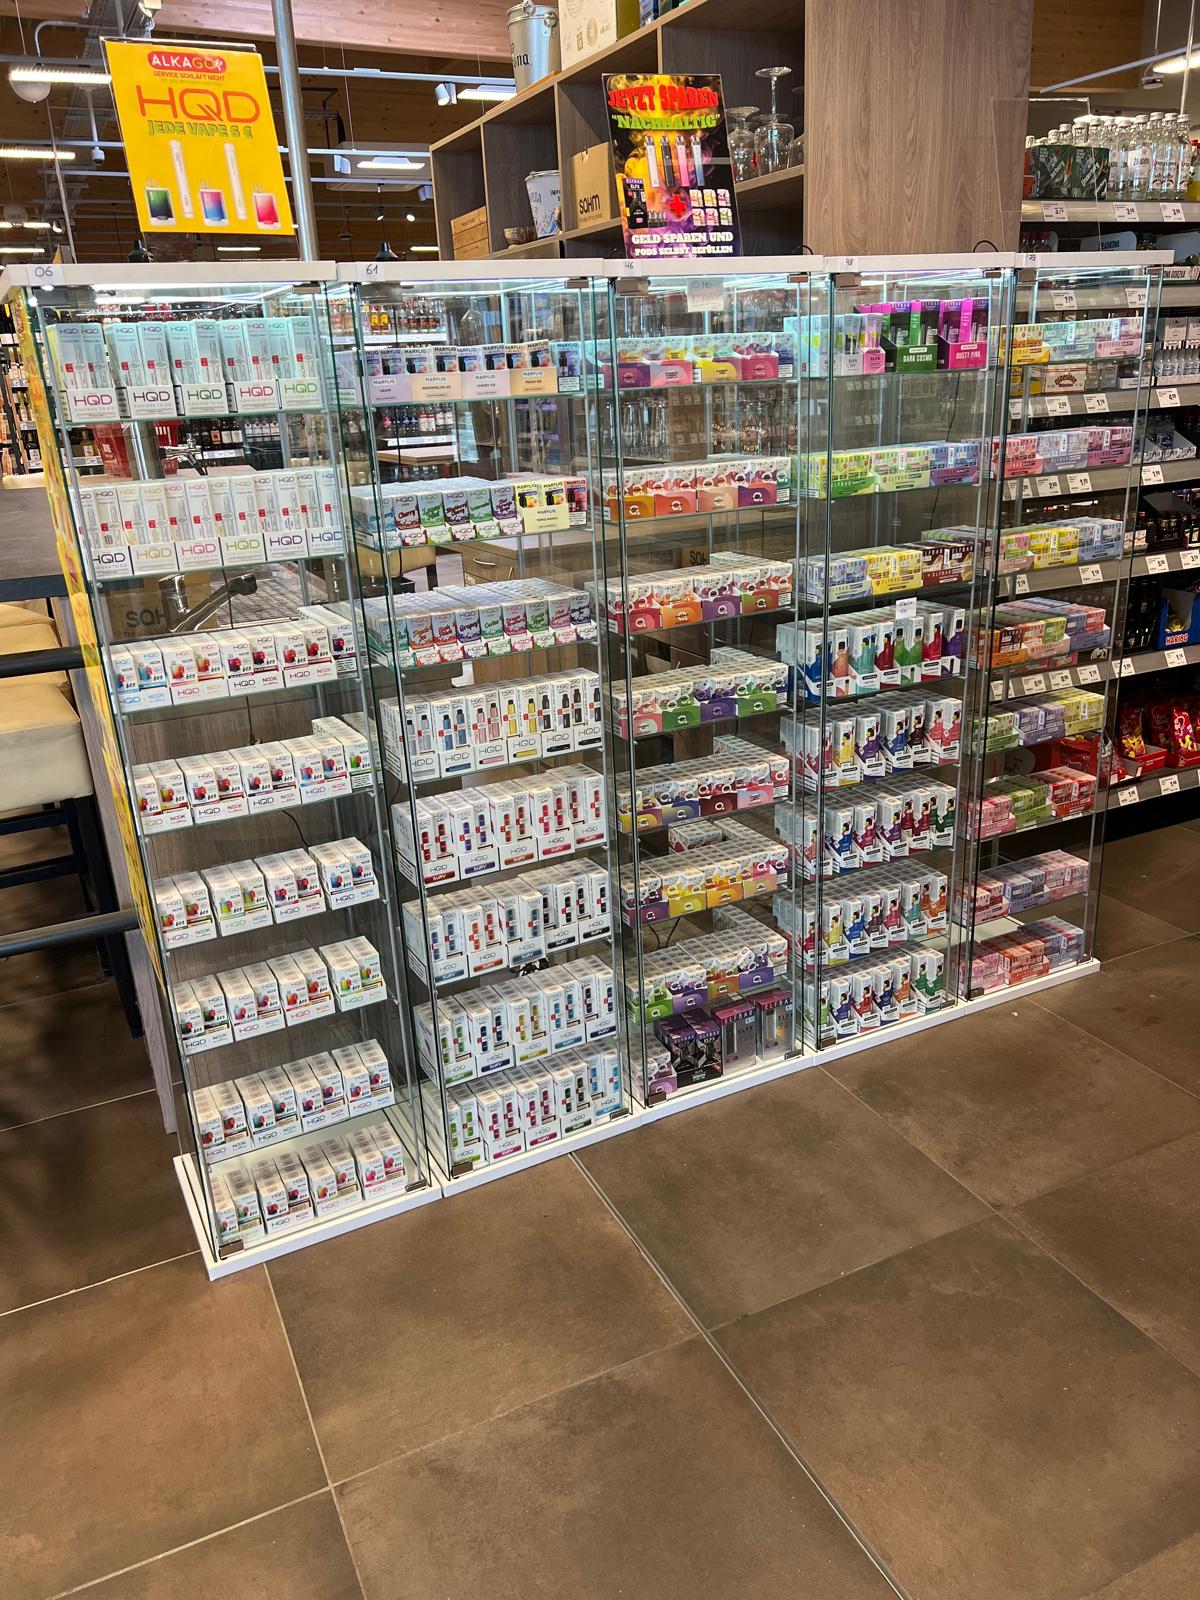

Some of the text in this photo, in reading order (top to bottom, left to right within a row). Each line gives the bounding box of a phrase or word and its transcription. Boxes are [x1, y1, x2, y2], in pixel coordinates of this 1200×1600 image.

[151, 53, 217, 71] ALKAGO
[153, 71, 179, 79] SERVICE
[208, 74, 225, 82] NICHT
[608, 85, 720, 111] JETZT SPAREN
[136, 85, 261, 124] HQD
[147, 120, 254, 139] JEDE VAPE 6 €
[632, 232, 734, 245] GELD SPAREN UND
[635, 248, 658, 256] PODS
[659, 247, 691, 255] SELBST
[903, 355, 916, 363] DARK
[240, 386, 274, 398] HQD
[284, 382, 318, 394] HQD
[74, 394, 113, 407] HQD
[133, 391, 171, 403] HQD
[187, 389, 223, 401] HQD
[226, 540, 260, 551] HQD
[270, 535, 303, 547] HQD
[136, 548, 172, 560] HQD
[181, 543, 216, 556] HQD
[93, 553, 126, 565] HQD
[1165, 632, 1189, 646] HARIBO
[289, 671, 311, 679] HQD
[234, 680, 256, 688] HQD
[177, 687, 200, 696] HQD
[578, 726, 601, 736] HQD
[513, 738, 536, 748] HQD
[546, 733, 570, 743] HQD
[479, 744, 503, 755] HQD
[445, 752, 470, 762] HQD
[306, 787, 326, 796] HQD
[253, 797, 275, 806] HQD
[199, 807, 221, 816] HQD
[335, 893, 356, 903] HQD
[280, 906, 301, 917] HQD
[167, 932, 189, 943] HQD
[290, 1010, 311, 1020] HQD
[724, 1010, 753, 1025] ELFBAR
[239, 1024, 260, 1034] HQD
[185, 1038, 207, 1049] HQD
[353, 1101, 372, 1111] HQD
[306, 1114, 326, 1125] HQD
[258, 1131, 278, 1142] HQD
[368, 1184, 387, 1194] HQD
[271, 1218, 291, 1228] HQD
